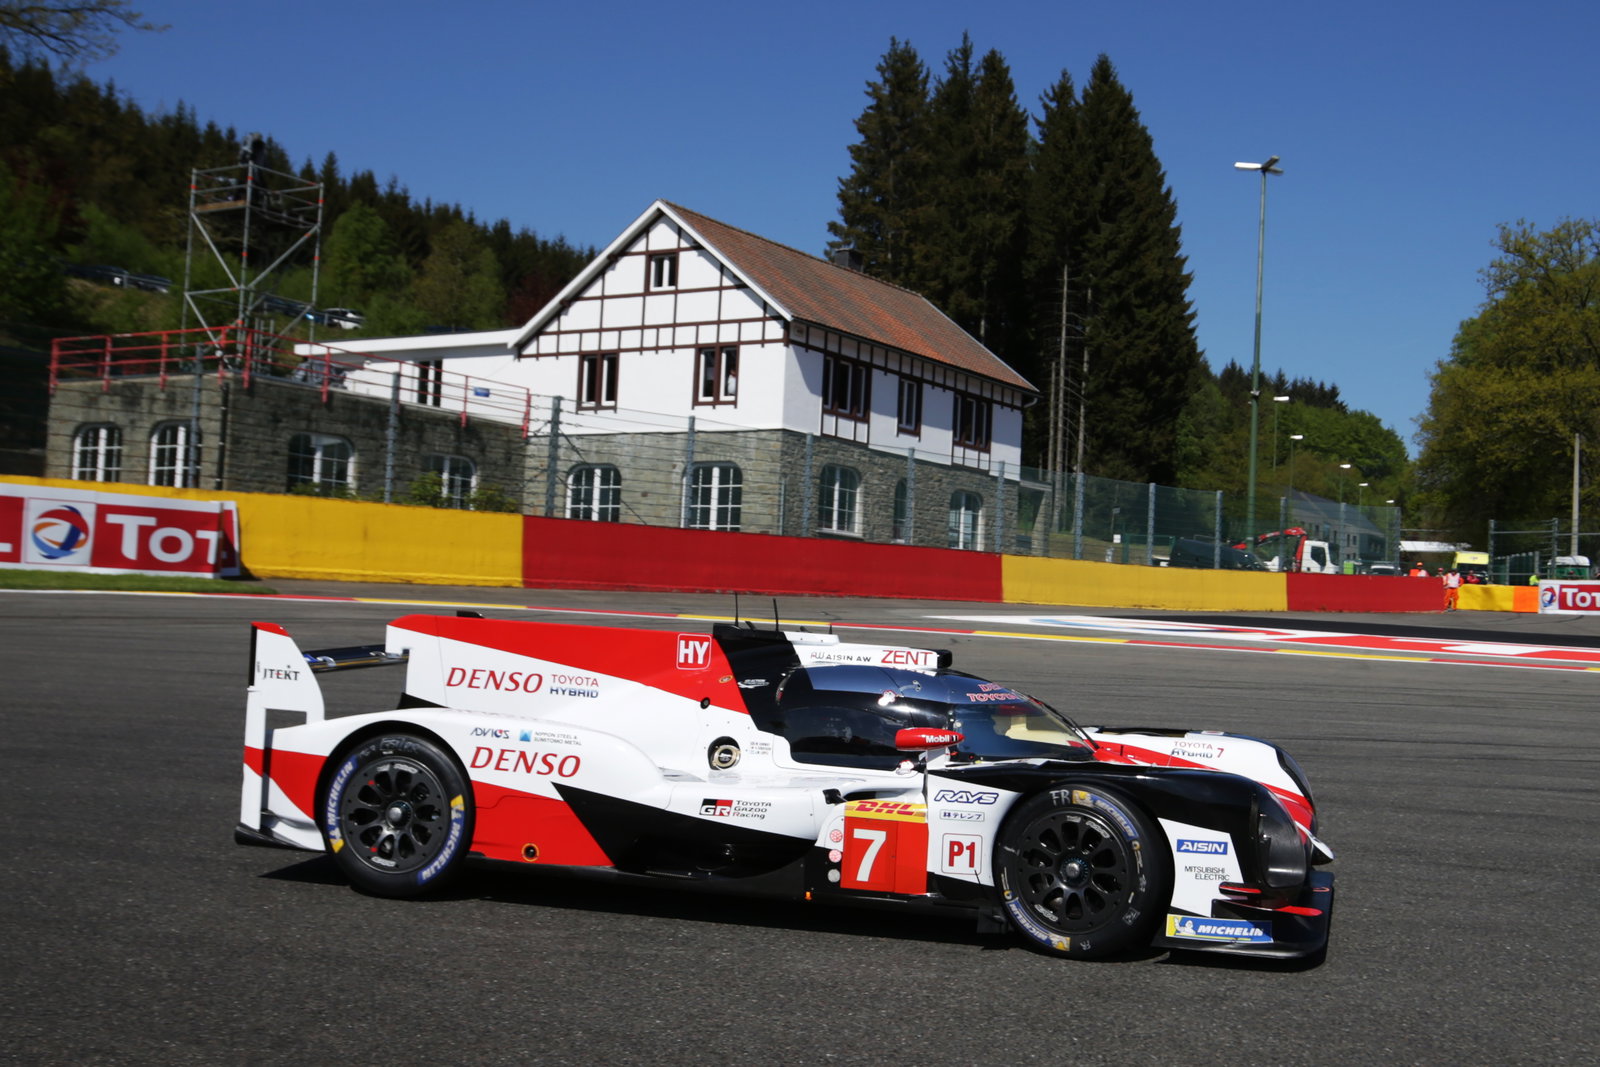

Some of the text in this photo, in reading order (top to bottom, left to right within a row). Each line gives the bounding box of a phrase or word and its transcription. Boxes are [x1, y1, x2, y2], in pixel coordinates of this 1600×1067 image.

[678, 640, 709, 664] HY
[881, 650, 933, 666] ZENT
[262, 667, 300, 681] JTEKT
[446, 667, 543, 693] DENSO
[551, 674, 599, 688] TOYOTA
[550, 687, 599, 698] HYBRID
[470, 727, 510, 739] ADVICS
[925, 734, 950, 743] Mobil
[1174, 741, 1213, 750] TOYOTA
[1217, 747, 1225, 758] 7
[470, 746, 581, 778] DENSO
[327, 761, 354, 828] MICHELIN
[934, 789, 999, 805] RAYS
[1049, 789, 1070, 806] FR
[700, 805, 731, 816] GR
[855, 800, 914, 816] DHL
[732, 811, 765, 820] Racing
[1095, 799, 1135, 837] MICHELIN
[422, 822, 461, 880] MICHELIN
[1180, 841, 1225, 852] AISIN
[853, 828, 887, 882] 7
[948, 841, 975, 868] P1
[1184, 866, 1225, 874] MITSUBISHI
[1195, 873, 1230, 881] ELECTRIC
[1197, 925, 1264, 936] MICHELIN
